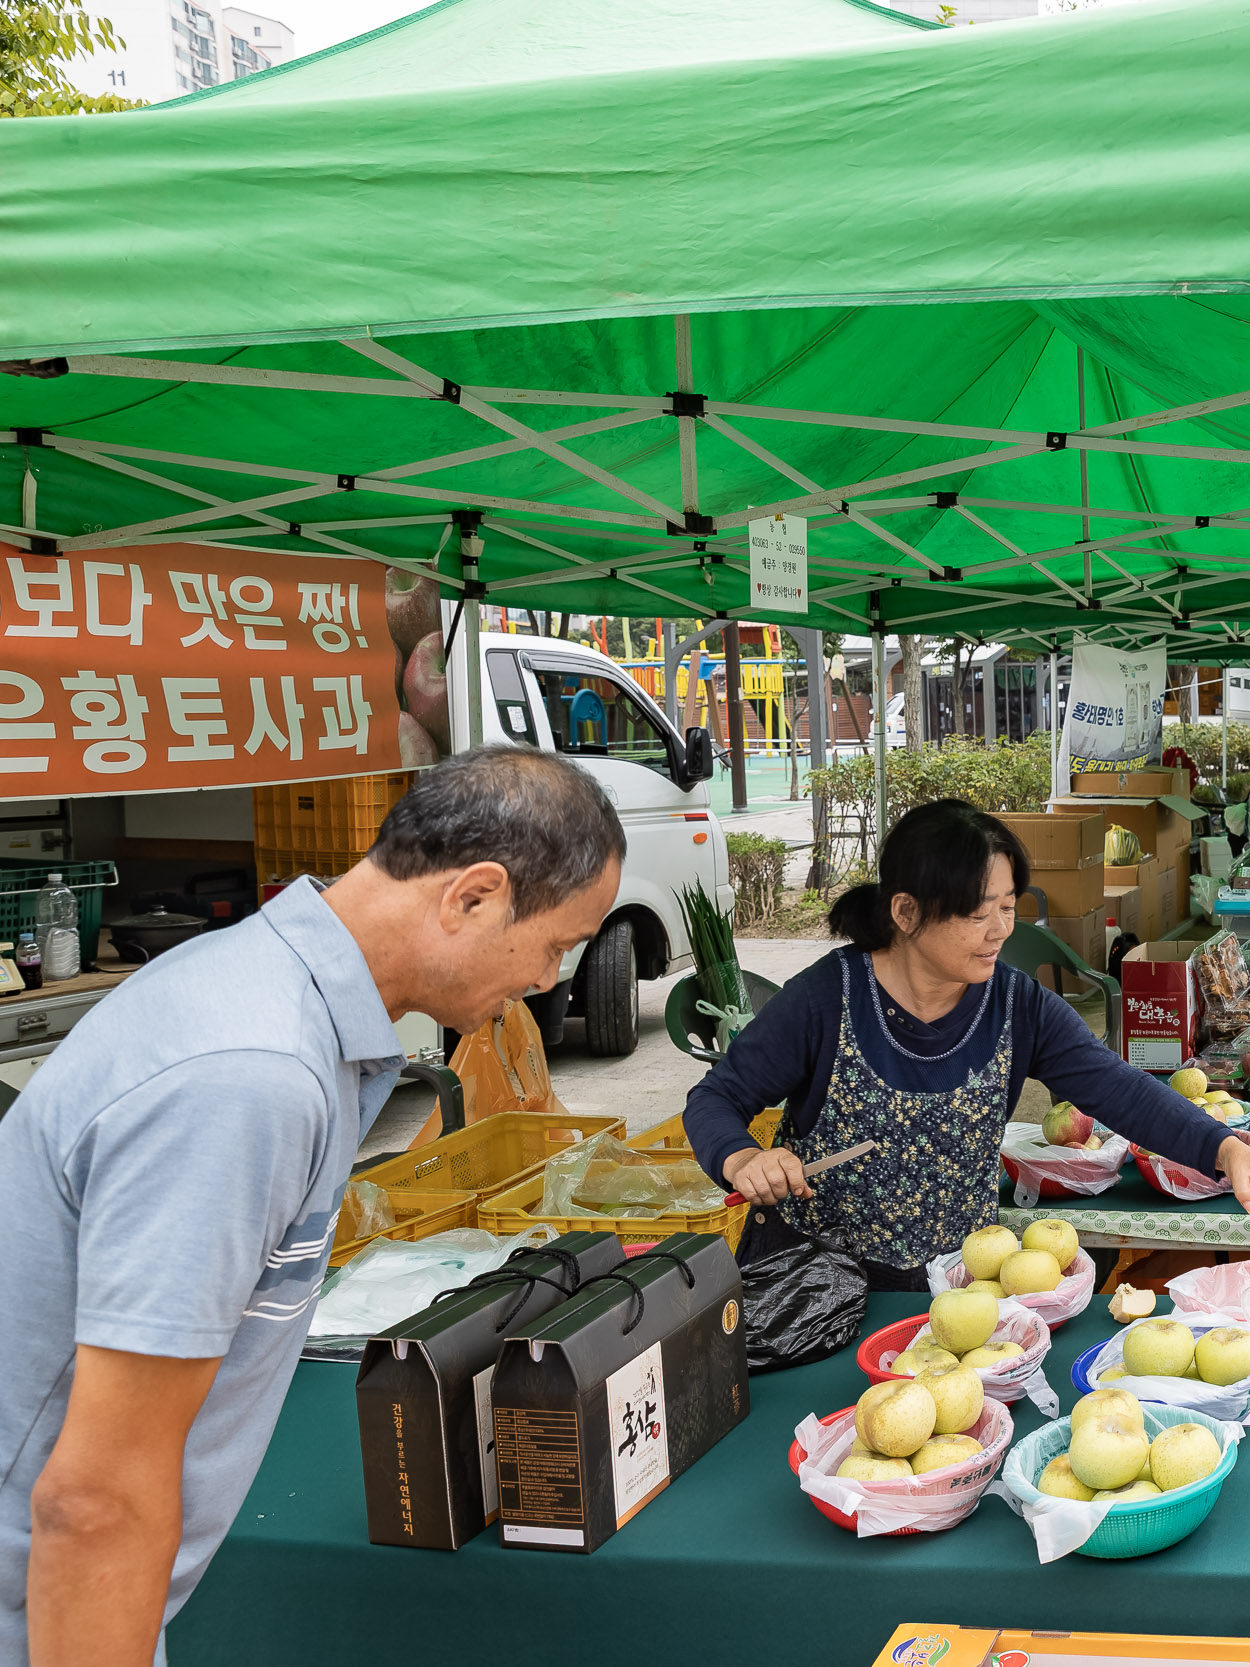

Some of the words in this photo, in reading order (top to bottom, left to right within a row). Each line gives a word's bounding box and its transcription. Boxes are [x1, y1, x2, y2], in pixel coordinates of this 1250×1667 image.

[4, 557, 153, 646] 보다
[167, 569, 288, 651] 맛은
[297, 582, 370, 654] 짱!
[1069, 754, 1086, 774] 도
[618, 1400, 657, 1457] 홍삼
[391, 1403, 403, 1439] 건강을
[398, 1472, 414, 1536] 자연에너지
